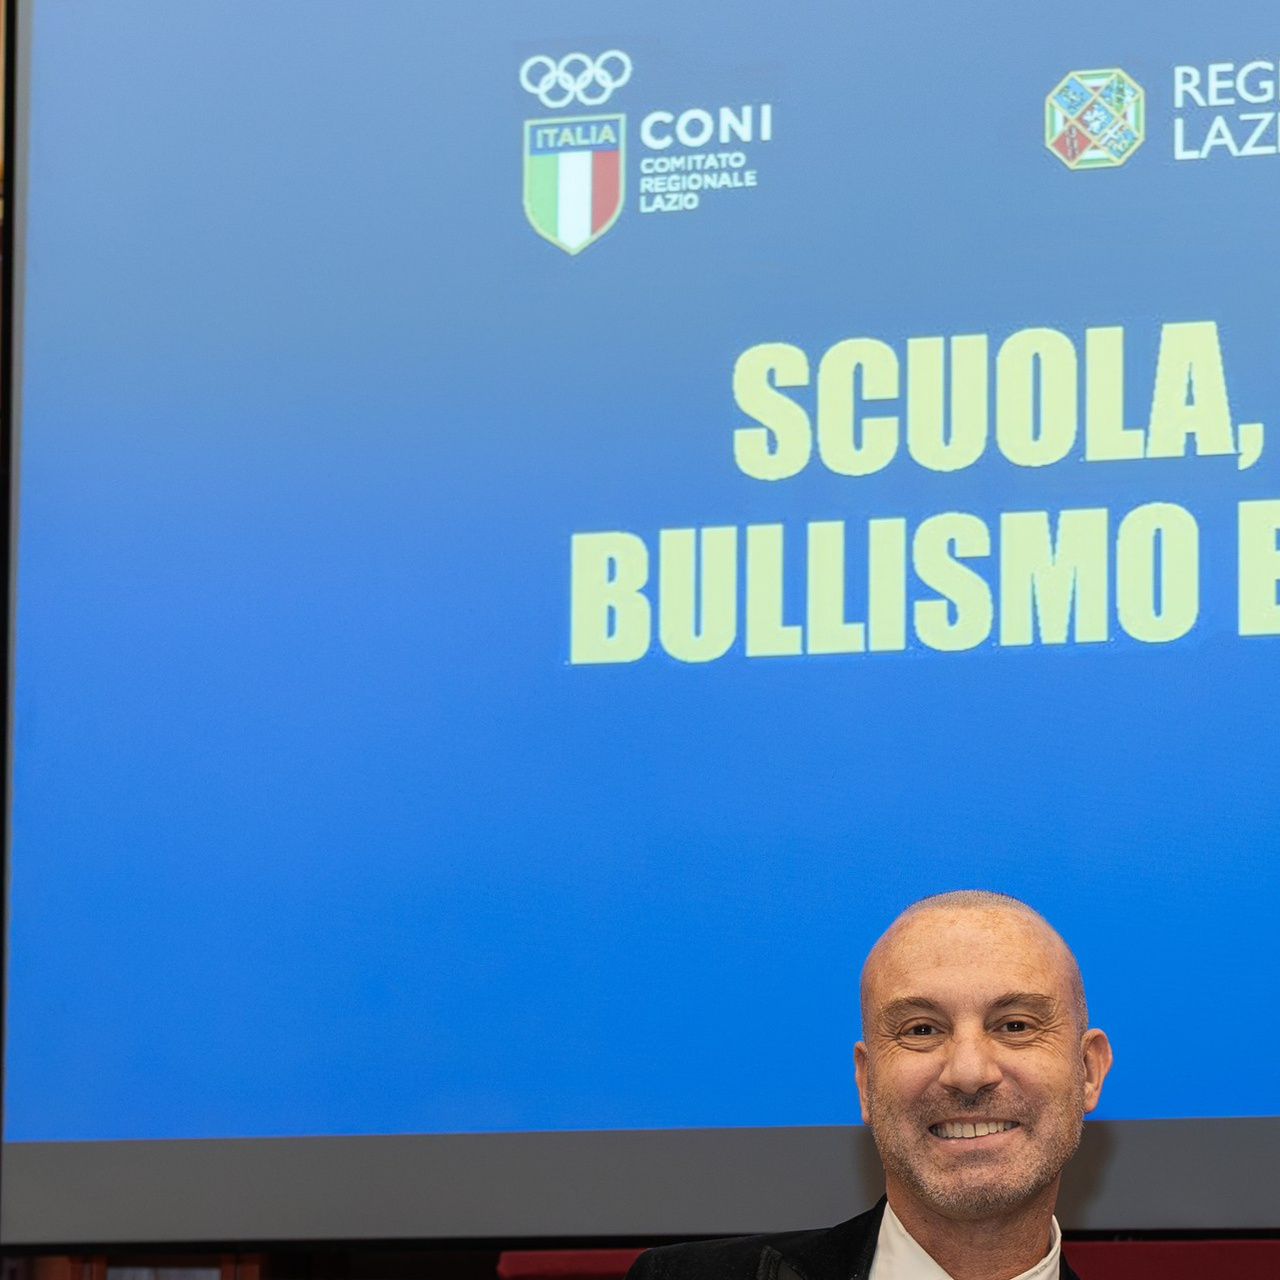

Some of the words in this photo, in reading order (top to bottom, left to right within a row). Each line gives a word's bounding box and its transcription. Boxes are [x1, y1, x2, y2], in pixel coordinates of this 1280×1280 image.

[536, 125, 616, 149] ITALIA
[640, 104, 772, 150] CONI
[640, 152, 746, 174] COMITATO
[640, 170, 758, 194] REGIONALE
[639, 192, 699, 213] LAZIO
[731, 319, 1265, 482] SCUOLA,
[567, 500, 1200, 665] BULLISMO
